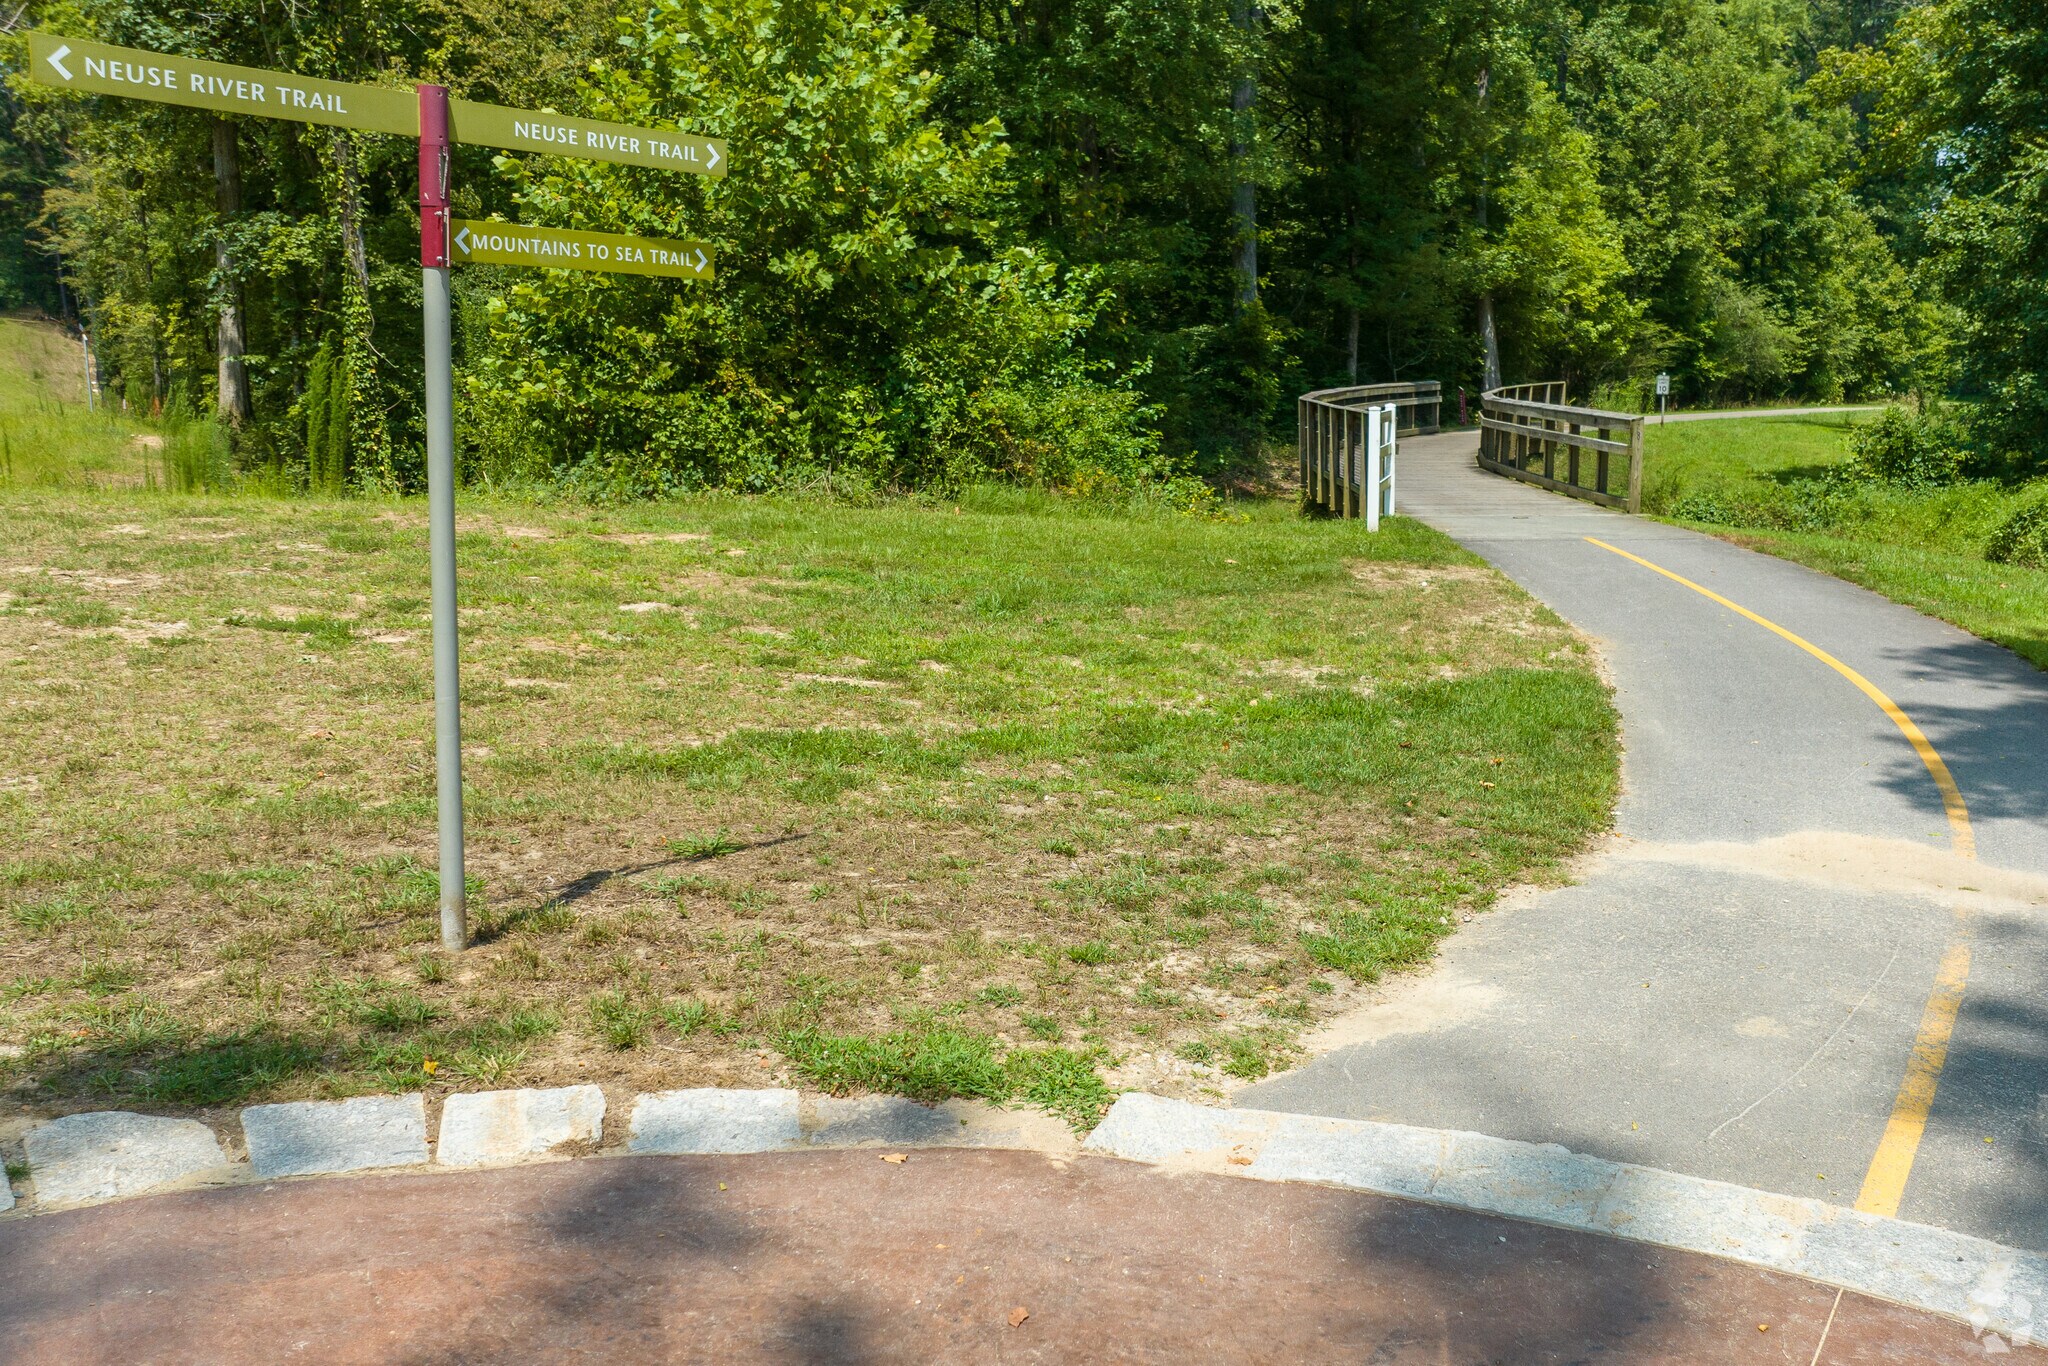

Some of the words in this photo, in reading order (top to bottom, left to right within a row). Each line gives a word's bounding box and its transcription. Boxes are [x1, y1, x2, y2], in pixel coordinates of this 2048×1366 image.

[85, 56, 178, 89] NEUSE
[190, 73, 266, 102] RIVER
[275, 86, 348, 114] TRAIL
[514, 121, 578, 145] NEUSE
[587, 131, 640, 154] RIVER
[647, 140, 699, 162] TRAIL
[472, 234, 580, 258] MOUNTAINS
[587, 243, 609, 260] TO
[615, 246, 645, 263] SEA
[650, 249, 693, 267] TRAIL
